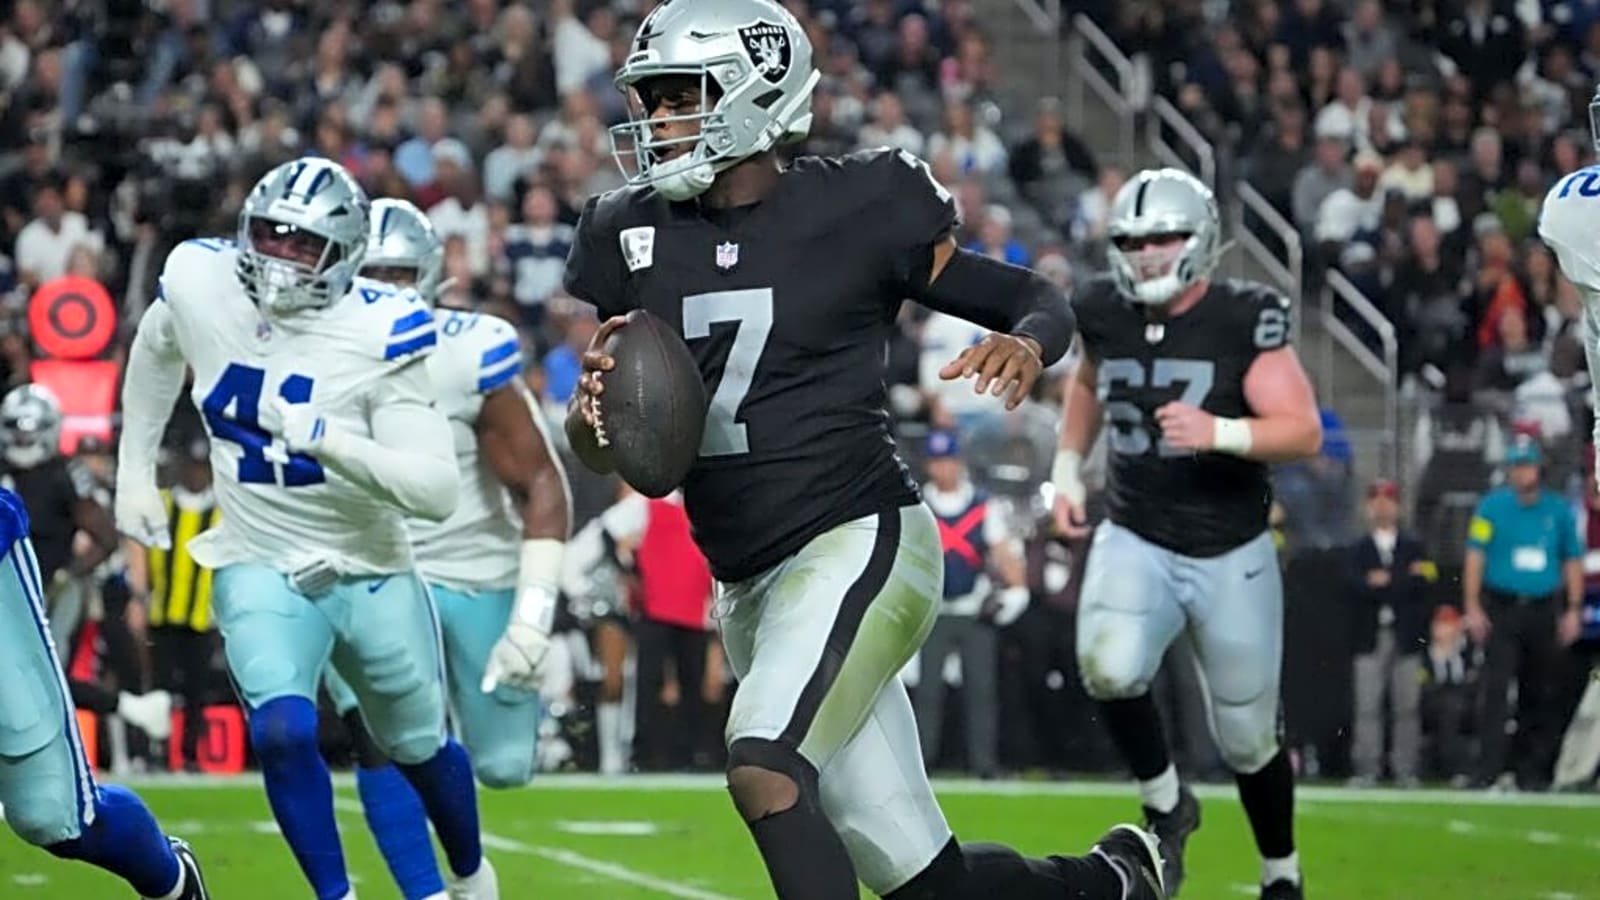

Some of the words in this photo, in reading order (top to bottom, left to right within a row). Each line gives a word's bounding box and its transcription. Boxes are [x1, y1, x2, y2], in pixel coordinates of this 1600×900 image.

[202, 362, 326, 488] 41
[682, 287, 773, 457] 7
[1097, 358, 1215, 457] 67
